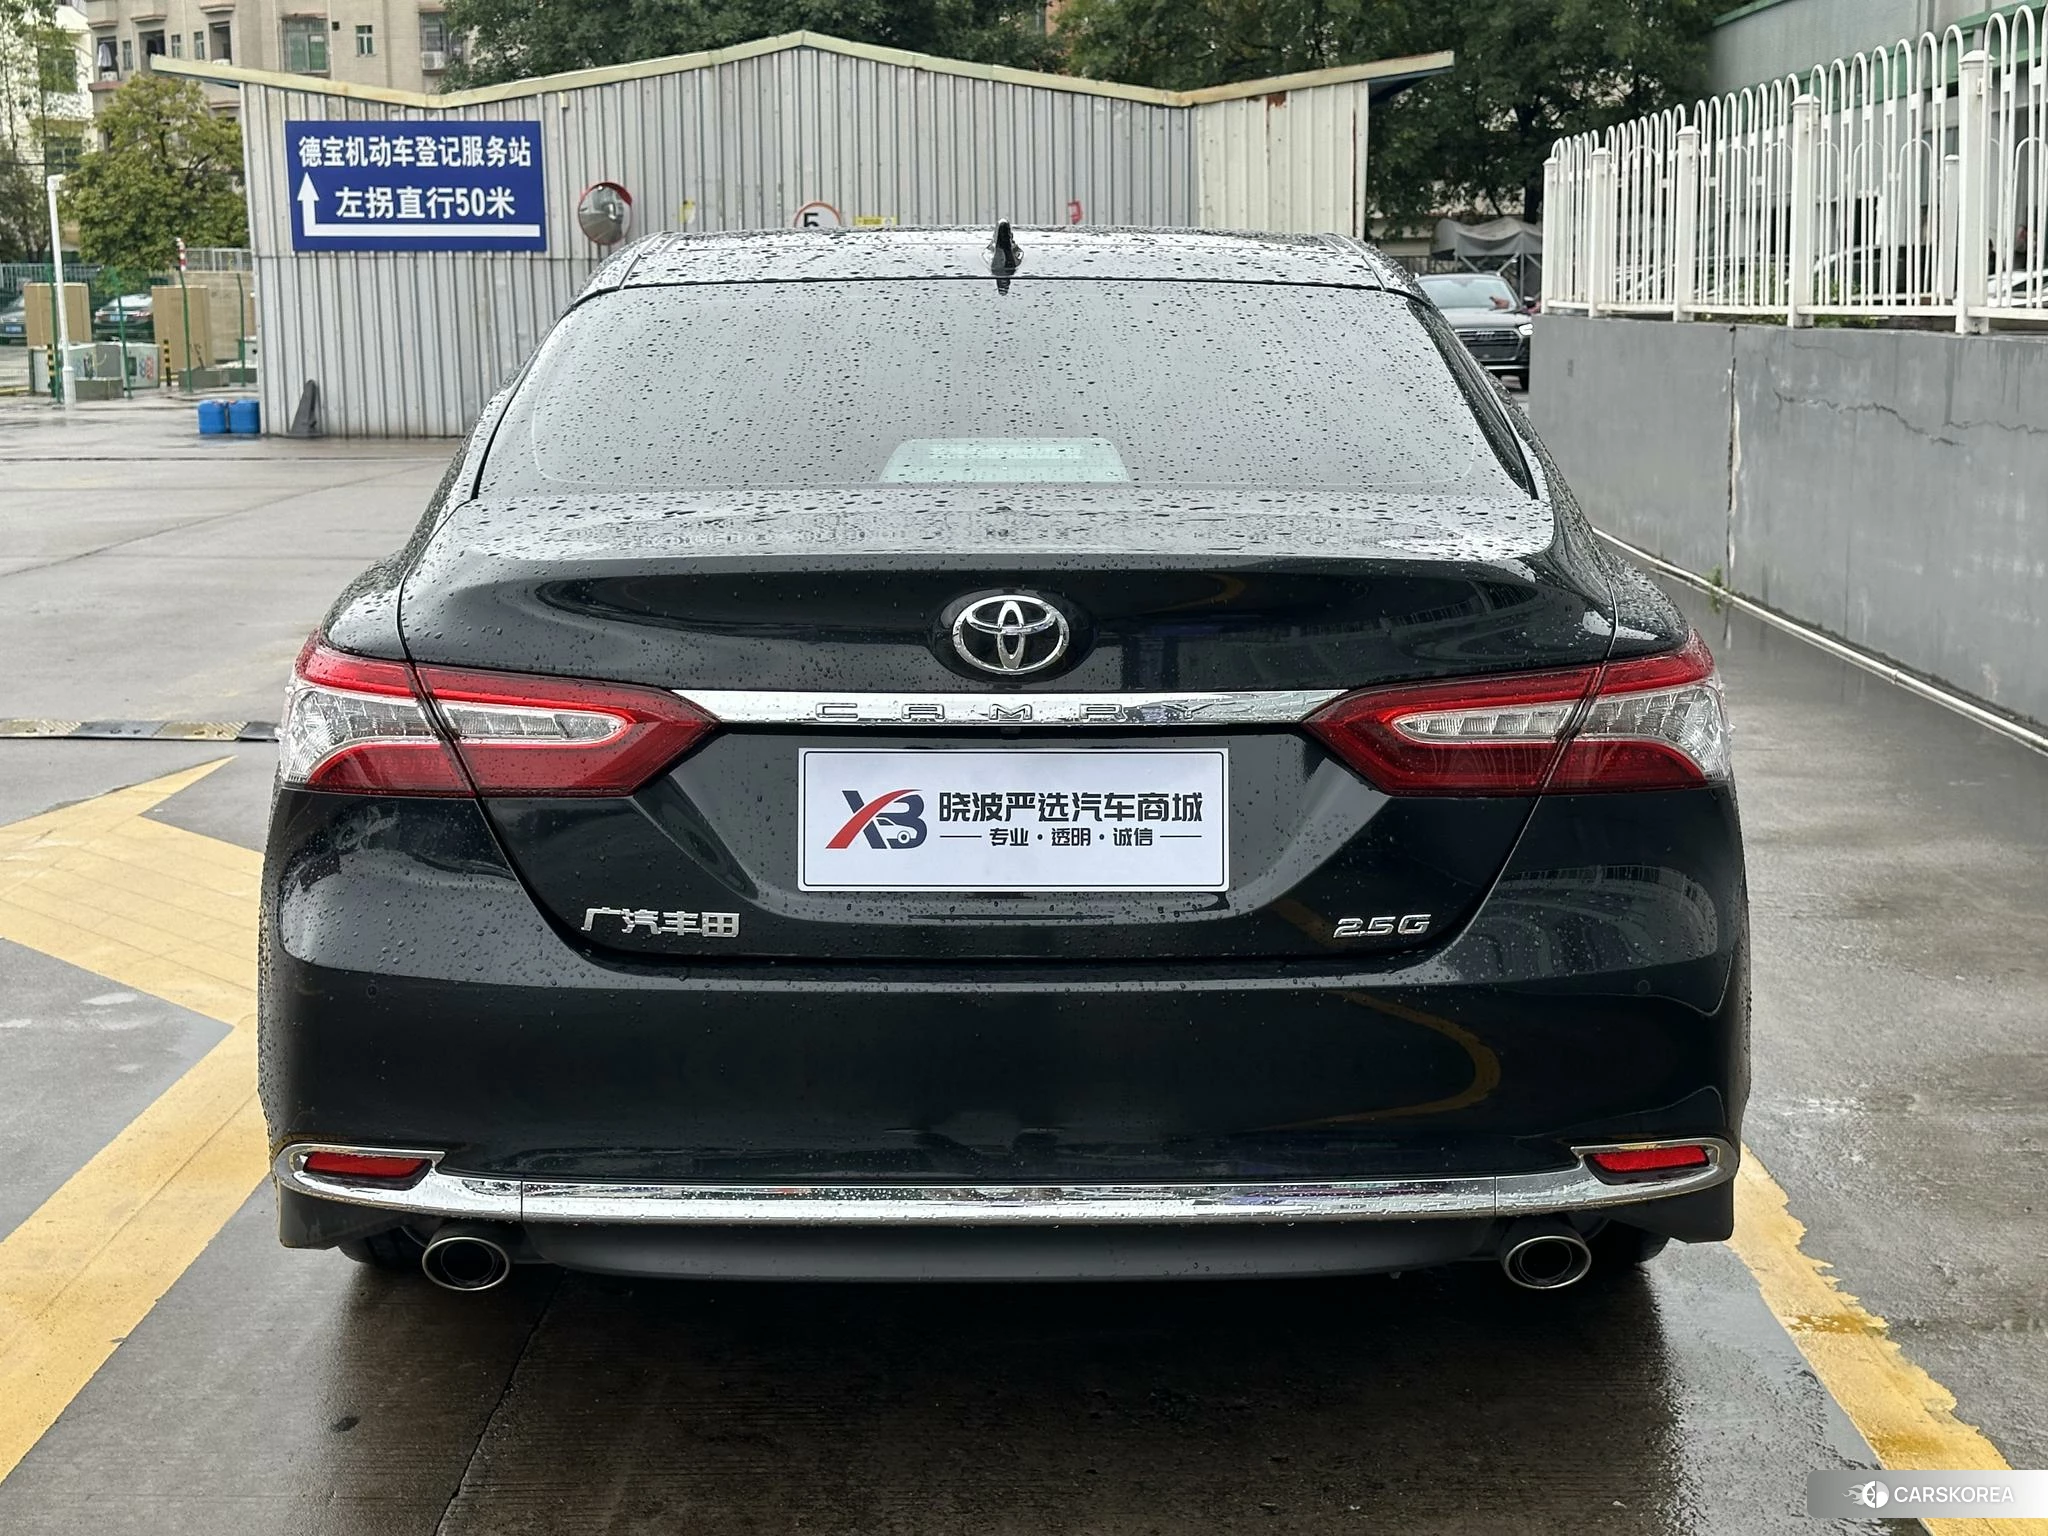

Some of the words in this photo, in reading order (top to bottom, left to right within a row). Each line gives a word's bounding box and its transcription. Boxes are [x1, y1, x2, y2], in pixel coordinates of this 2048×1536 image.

[298, 135, 532, 168] 德宝机动车登记服务站
[334, 186, 516, 219] 左拐直行50米
[814, 701, 1218, 722] CAMRY
[938, 791, 1203, 823] 晓波严选汽车商城
[580, 906, 740, 938] 广汽丰田
[1332, 913, 1432, 939] 2.5G
